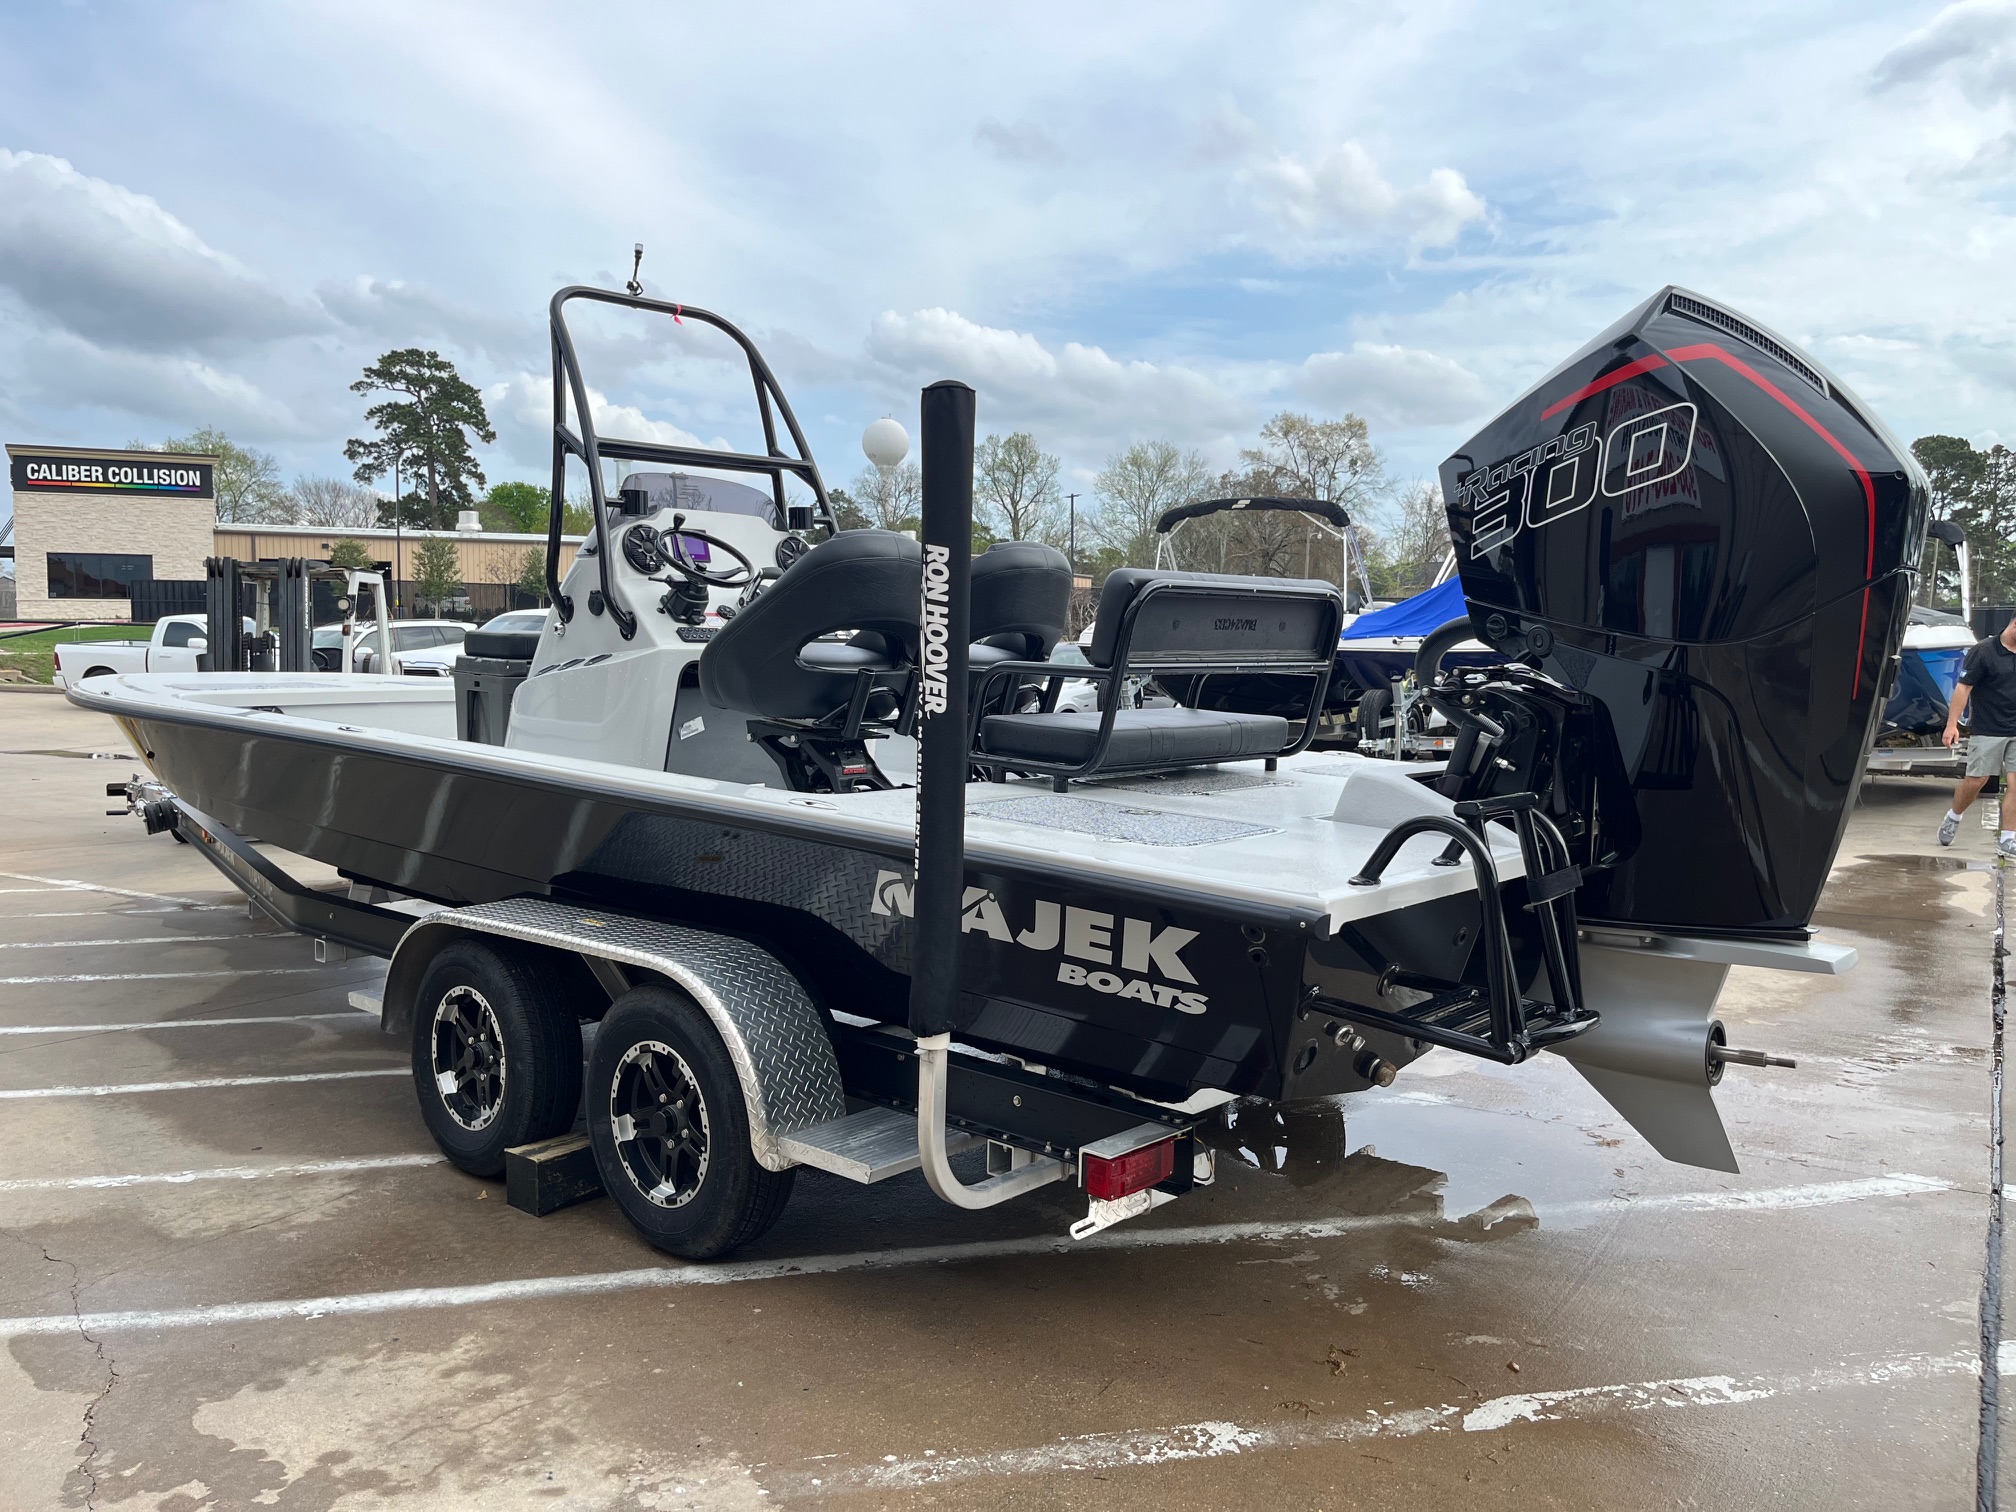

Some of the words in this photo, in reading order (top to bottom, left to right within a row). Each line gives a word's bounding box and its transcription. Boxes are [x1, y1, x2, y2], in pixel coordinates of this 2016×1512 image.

[26, 463, 103, 482] CALIBER
[107, 466, 200, 486] COLLISION
[1455, 421, 1597, 507] Racing
[1470, 402, 1698, 560] 300
[925, 543, 949, 603] RON
[925, 604, 949, 717] HOOVER
[1056, 962, 1209, 1015] BOATS
